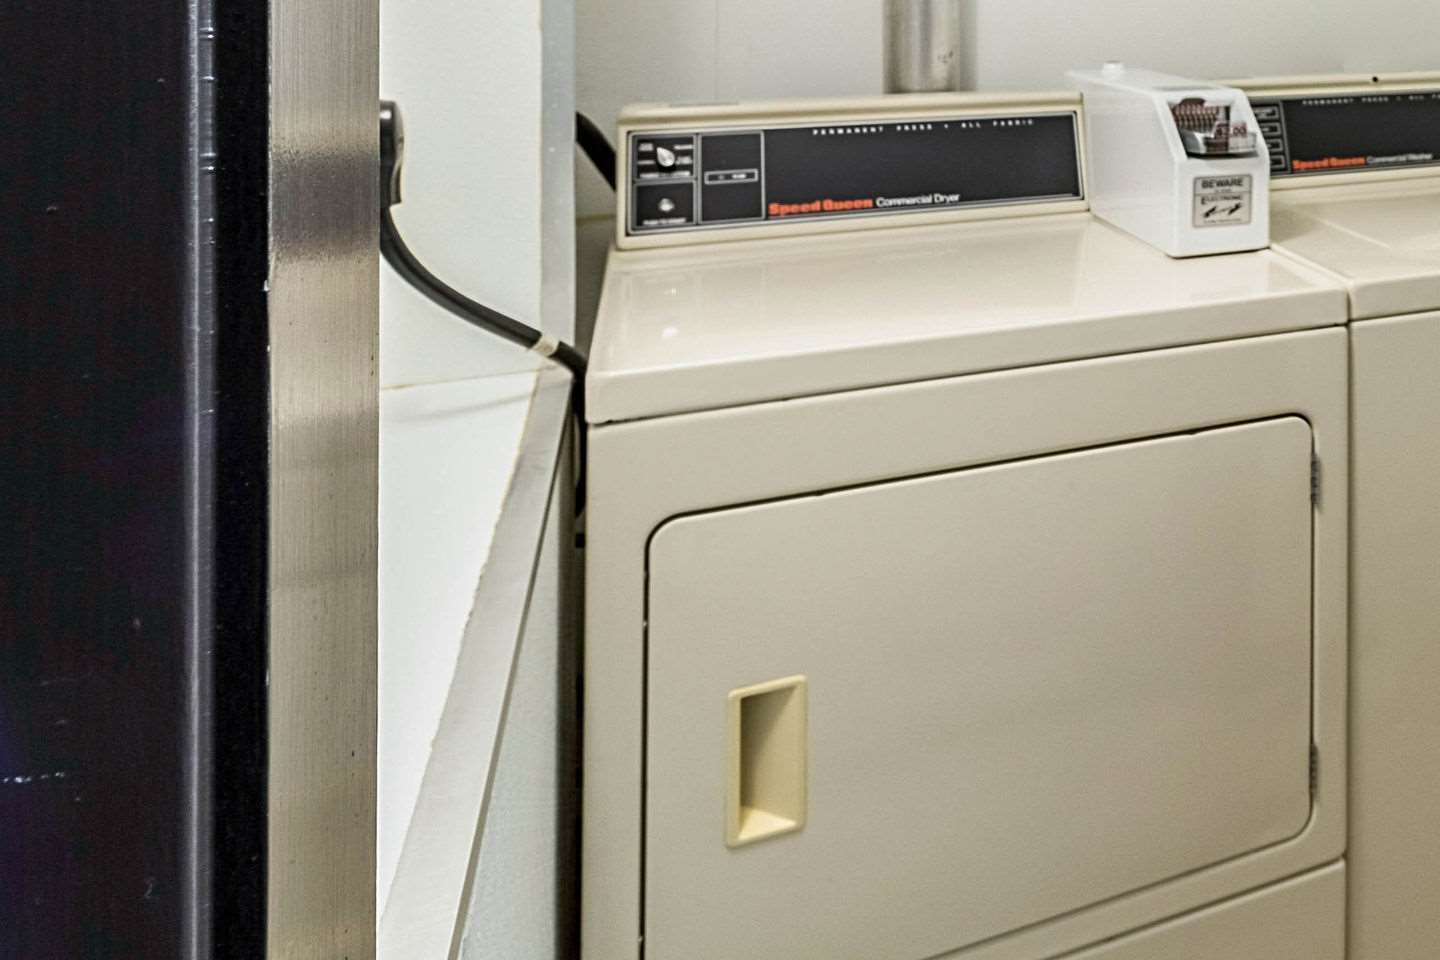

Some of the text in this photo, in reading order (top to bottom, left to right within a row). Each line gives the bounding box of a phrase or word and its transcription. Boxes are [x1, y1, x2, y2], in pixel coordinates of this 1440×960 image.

[1201, 178, 1244, 189] BEWARE
[768, 192, 960, 216] Speed Queen Commercial Dryer
